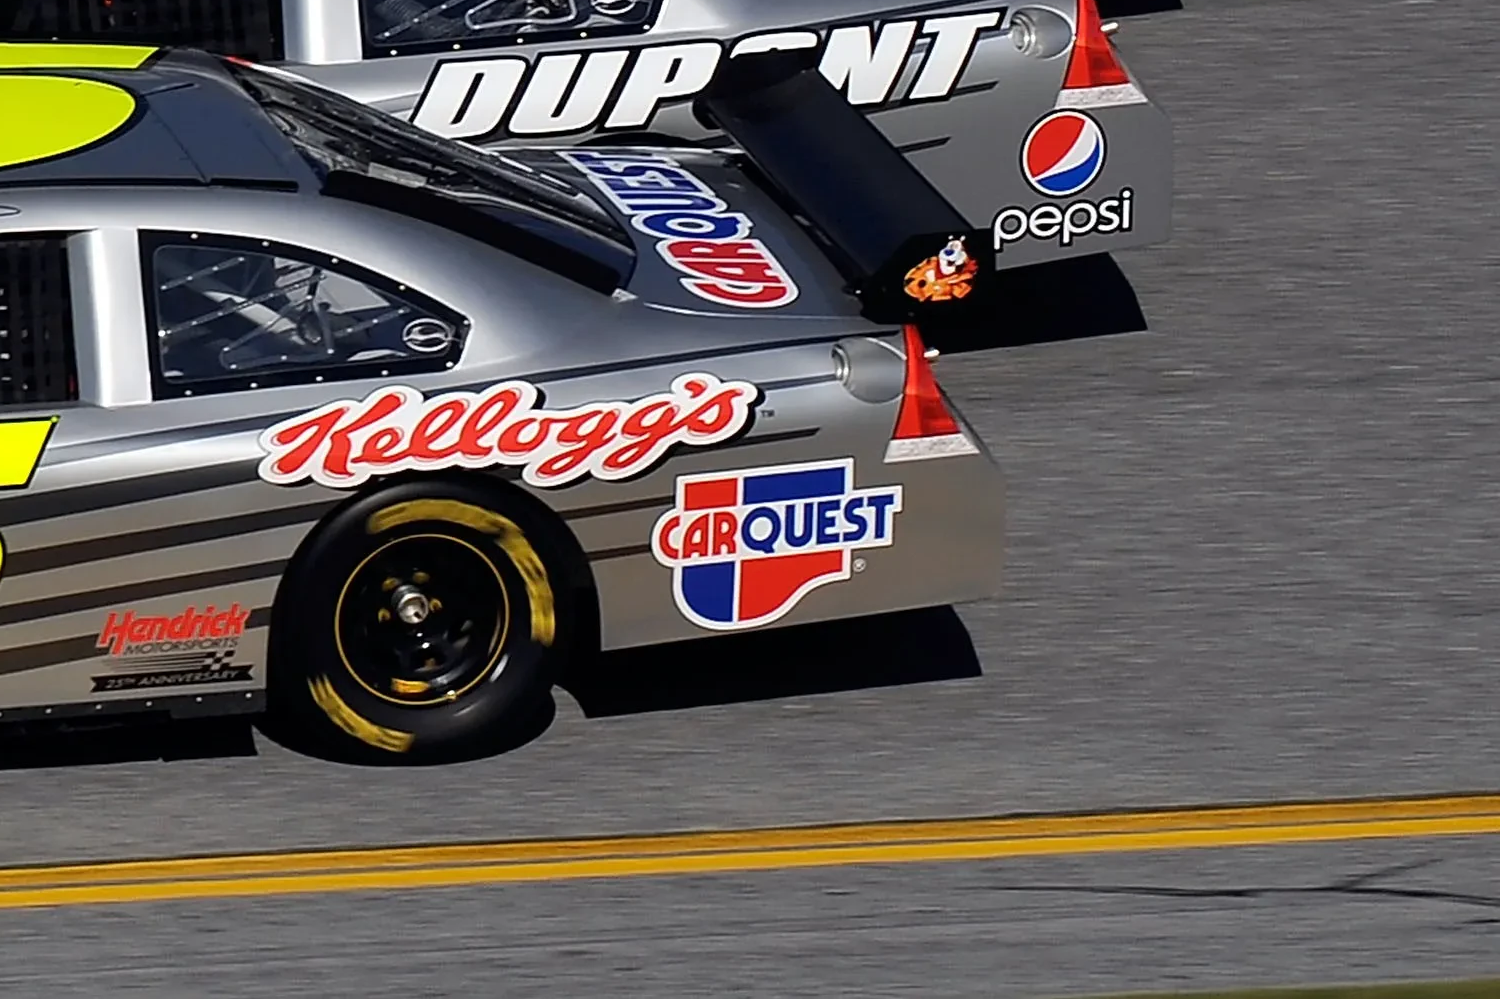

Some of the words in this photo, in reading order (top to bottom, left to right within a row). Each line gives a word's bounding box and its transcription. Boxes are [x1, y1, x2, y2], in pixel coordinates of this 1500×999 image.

[410, 11, 1001, 138] DUPNT
[562, 152, 792, 305] CARQUEST
[993, 189, 1132, 250] pepsi
[268, 377, 746, 481] Kellogg's
[658, 492, 896, 560] CARQUEST
[97, 601, 249, 656] Hendrick
[122, 638, 240, 655] MOTORSPORTS
[137, 669, 240, 687] ANNIVERSARY
